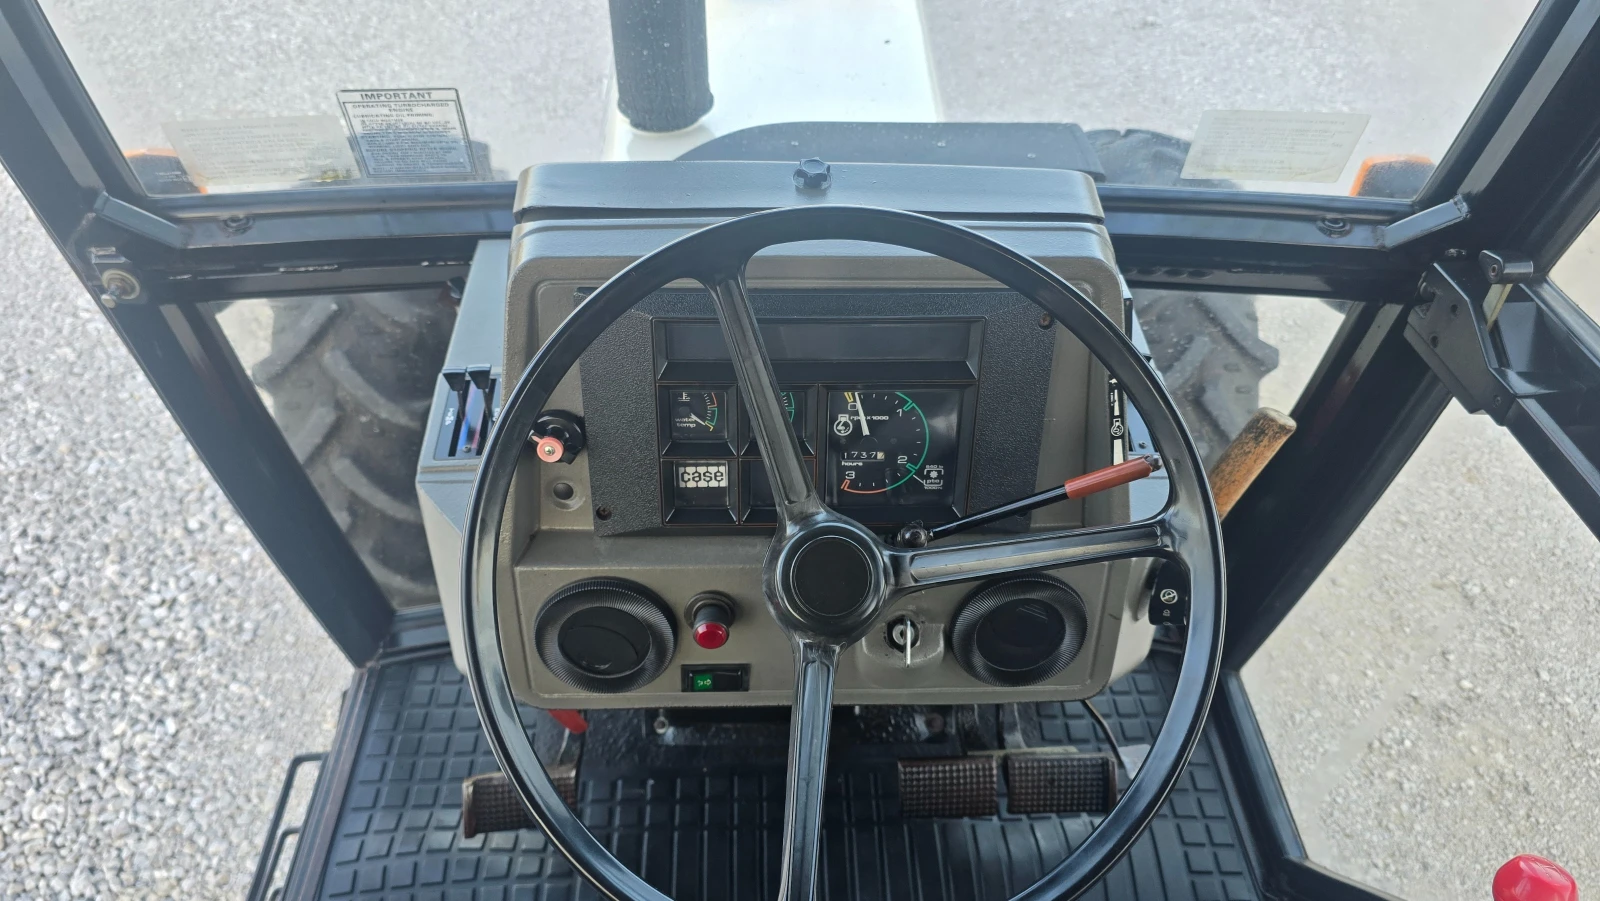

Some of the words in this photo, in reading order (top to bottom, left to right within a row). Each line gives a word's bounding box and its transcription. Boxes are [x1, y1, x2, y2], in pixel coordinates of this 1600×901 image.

[359, 91, 433, 101] IMPORTANT
[897, 455, 908, 464] 2
[680, 470, 724, 483] case
[845, 470, 856, 480] 3
